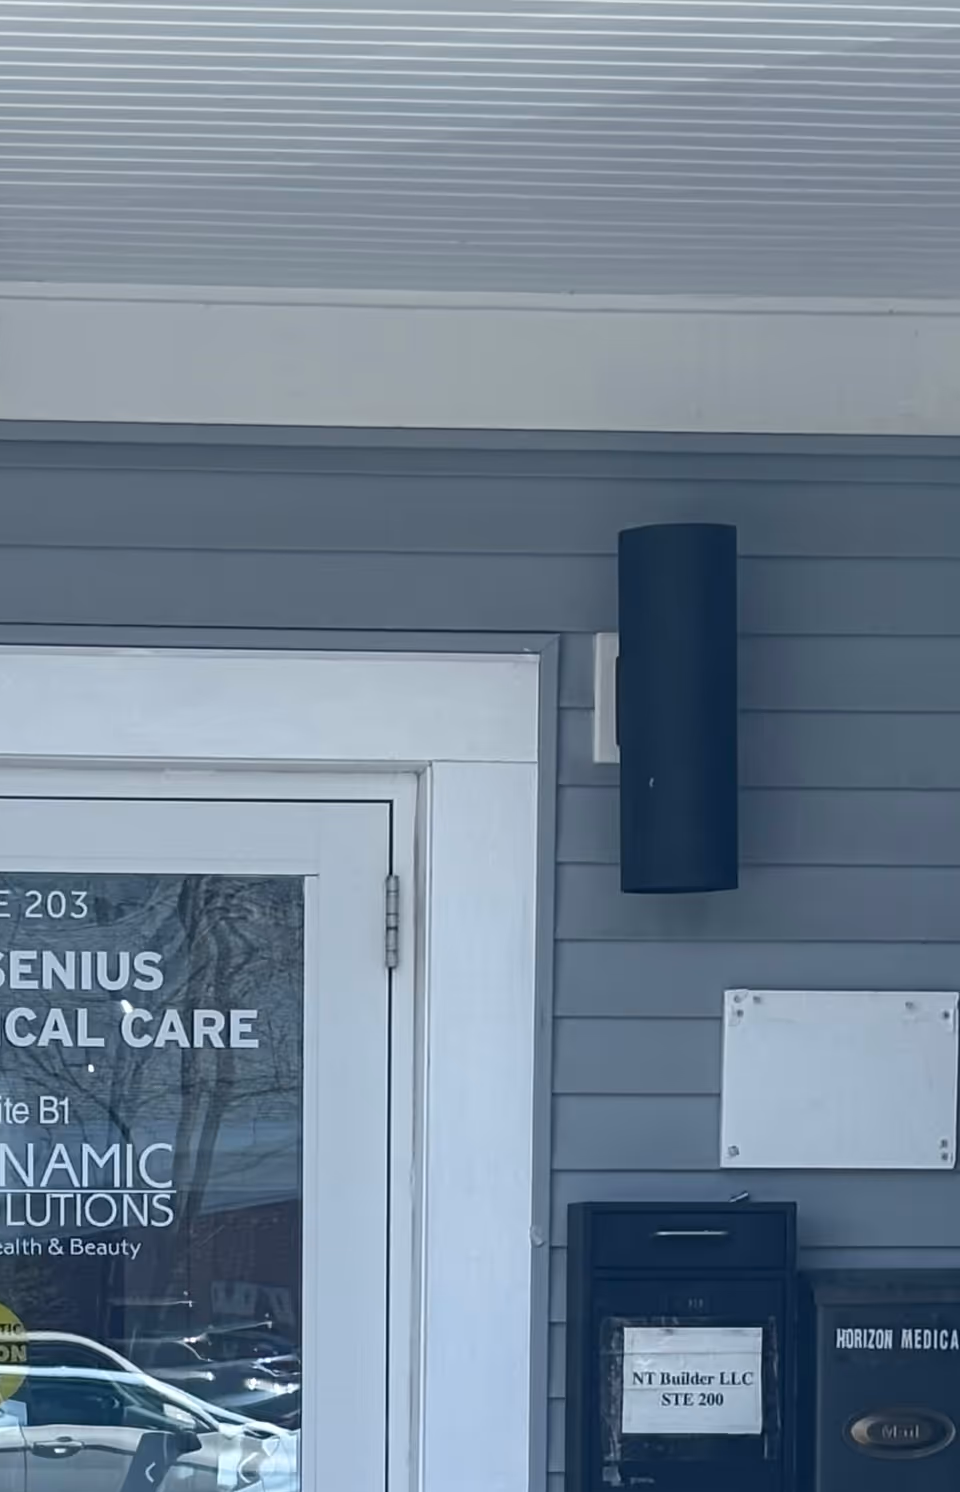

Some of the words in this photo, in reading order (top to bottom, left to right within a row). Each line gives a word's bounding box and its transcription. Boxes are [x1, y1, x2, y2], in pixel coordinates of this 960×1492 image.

[25, 890, 88, 918] 203
[121, 1009, 259, 1048] CARE
[40, 1095, 71, 1124] B1
[48, 1239, 64, 1256] &
[70, 1239, 141, 1260] Beauty
[836, 1328, 893, 1349] HORIZON
[632, 1372, 656, 1385] NT
[660, 1372, 715, 1386] Builder
[719, 1372, 754, 1386] LLC
[661, 1393, 694, 1406] STE
[699, 1393, 724, 1406] 200
